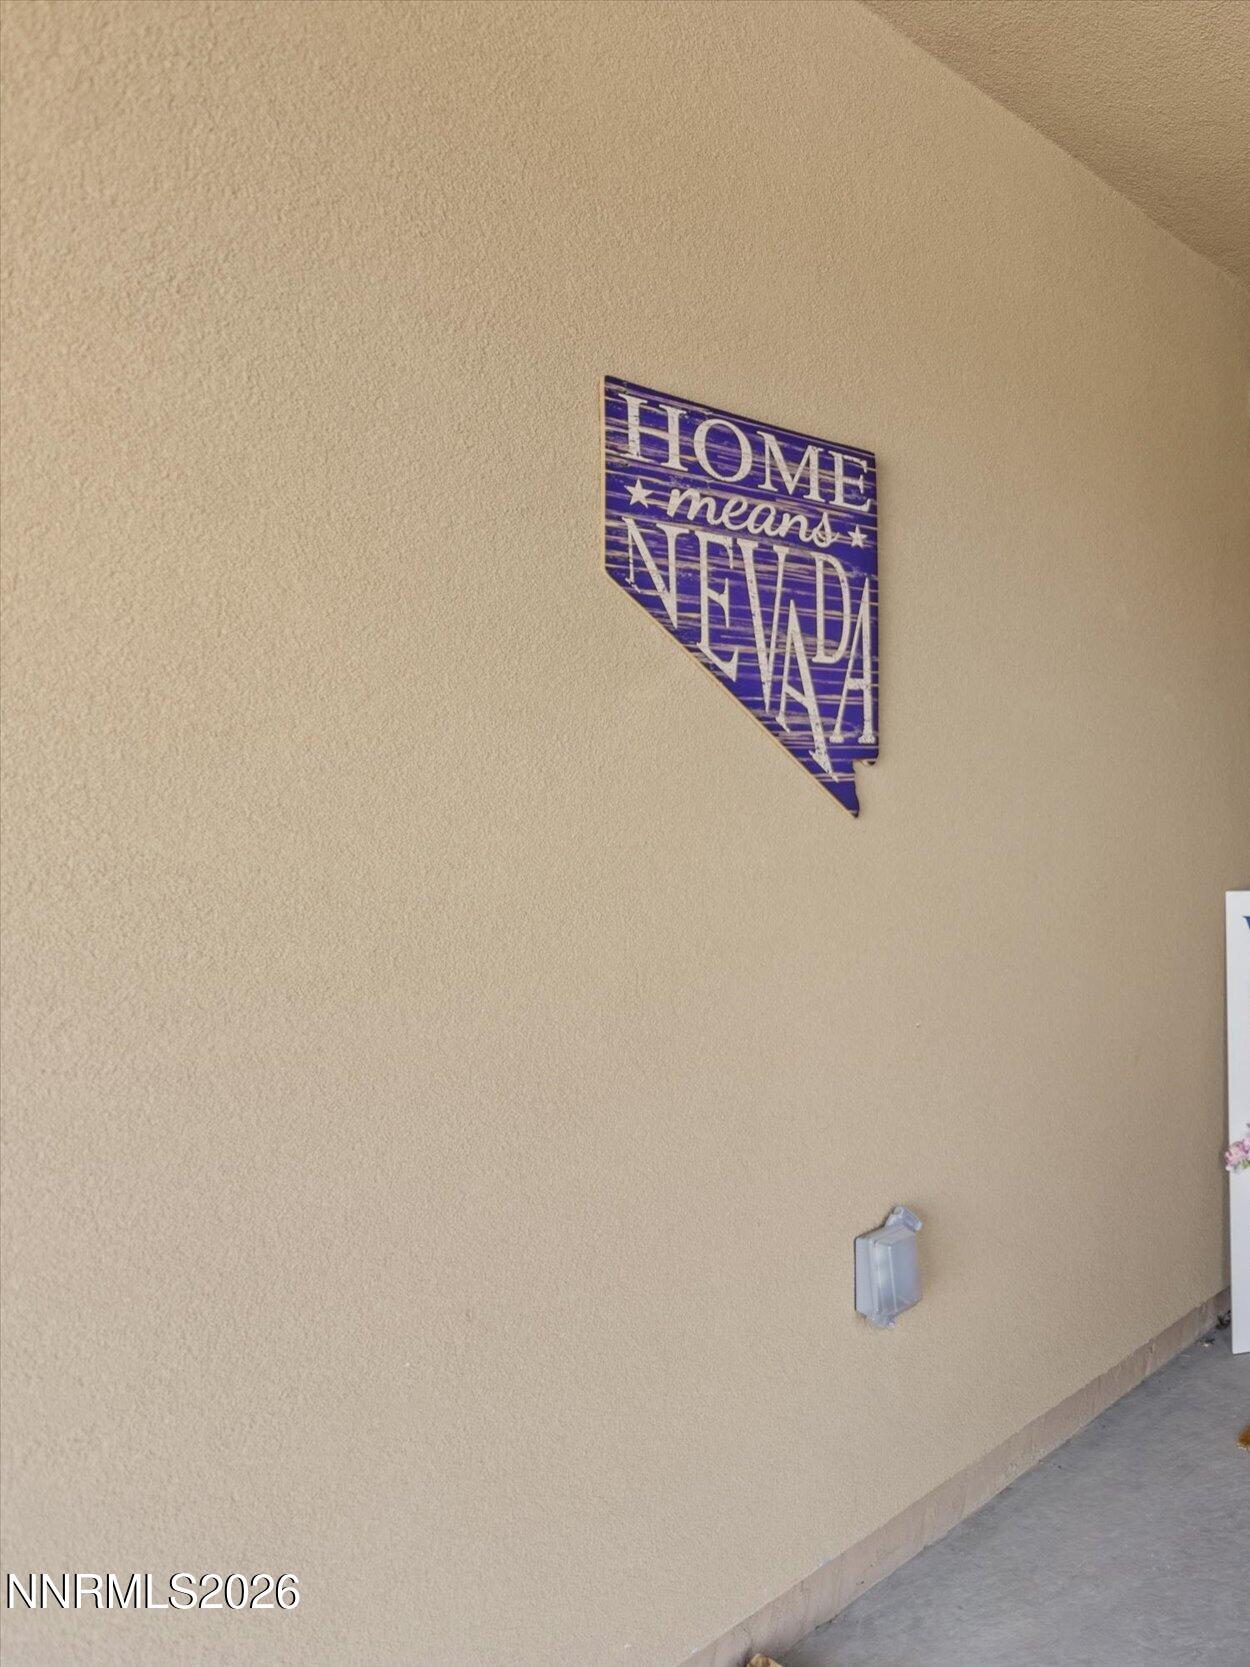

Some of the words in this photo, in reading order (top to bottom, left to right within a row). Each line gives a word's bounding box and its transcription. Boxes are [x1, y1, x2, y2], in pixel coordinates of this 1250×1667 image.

[618, 393, 870, 512] HOME
[666, 486, 838, 549] means
[621, 517, 876, 782] NEVADA
